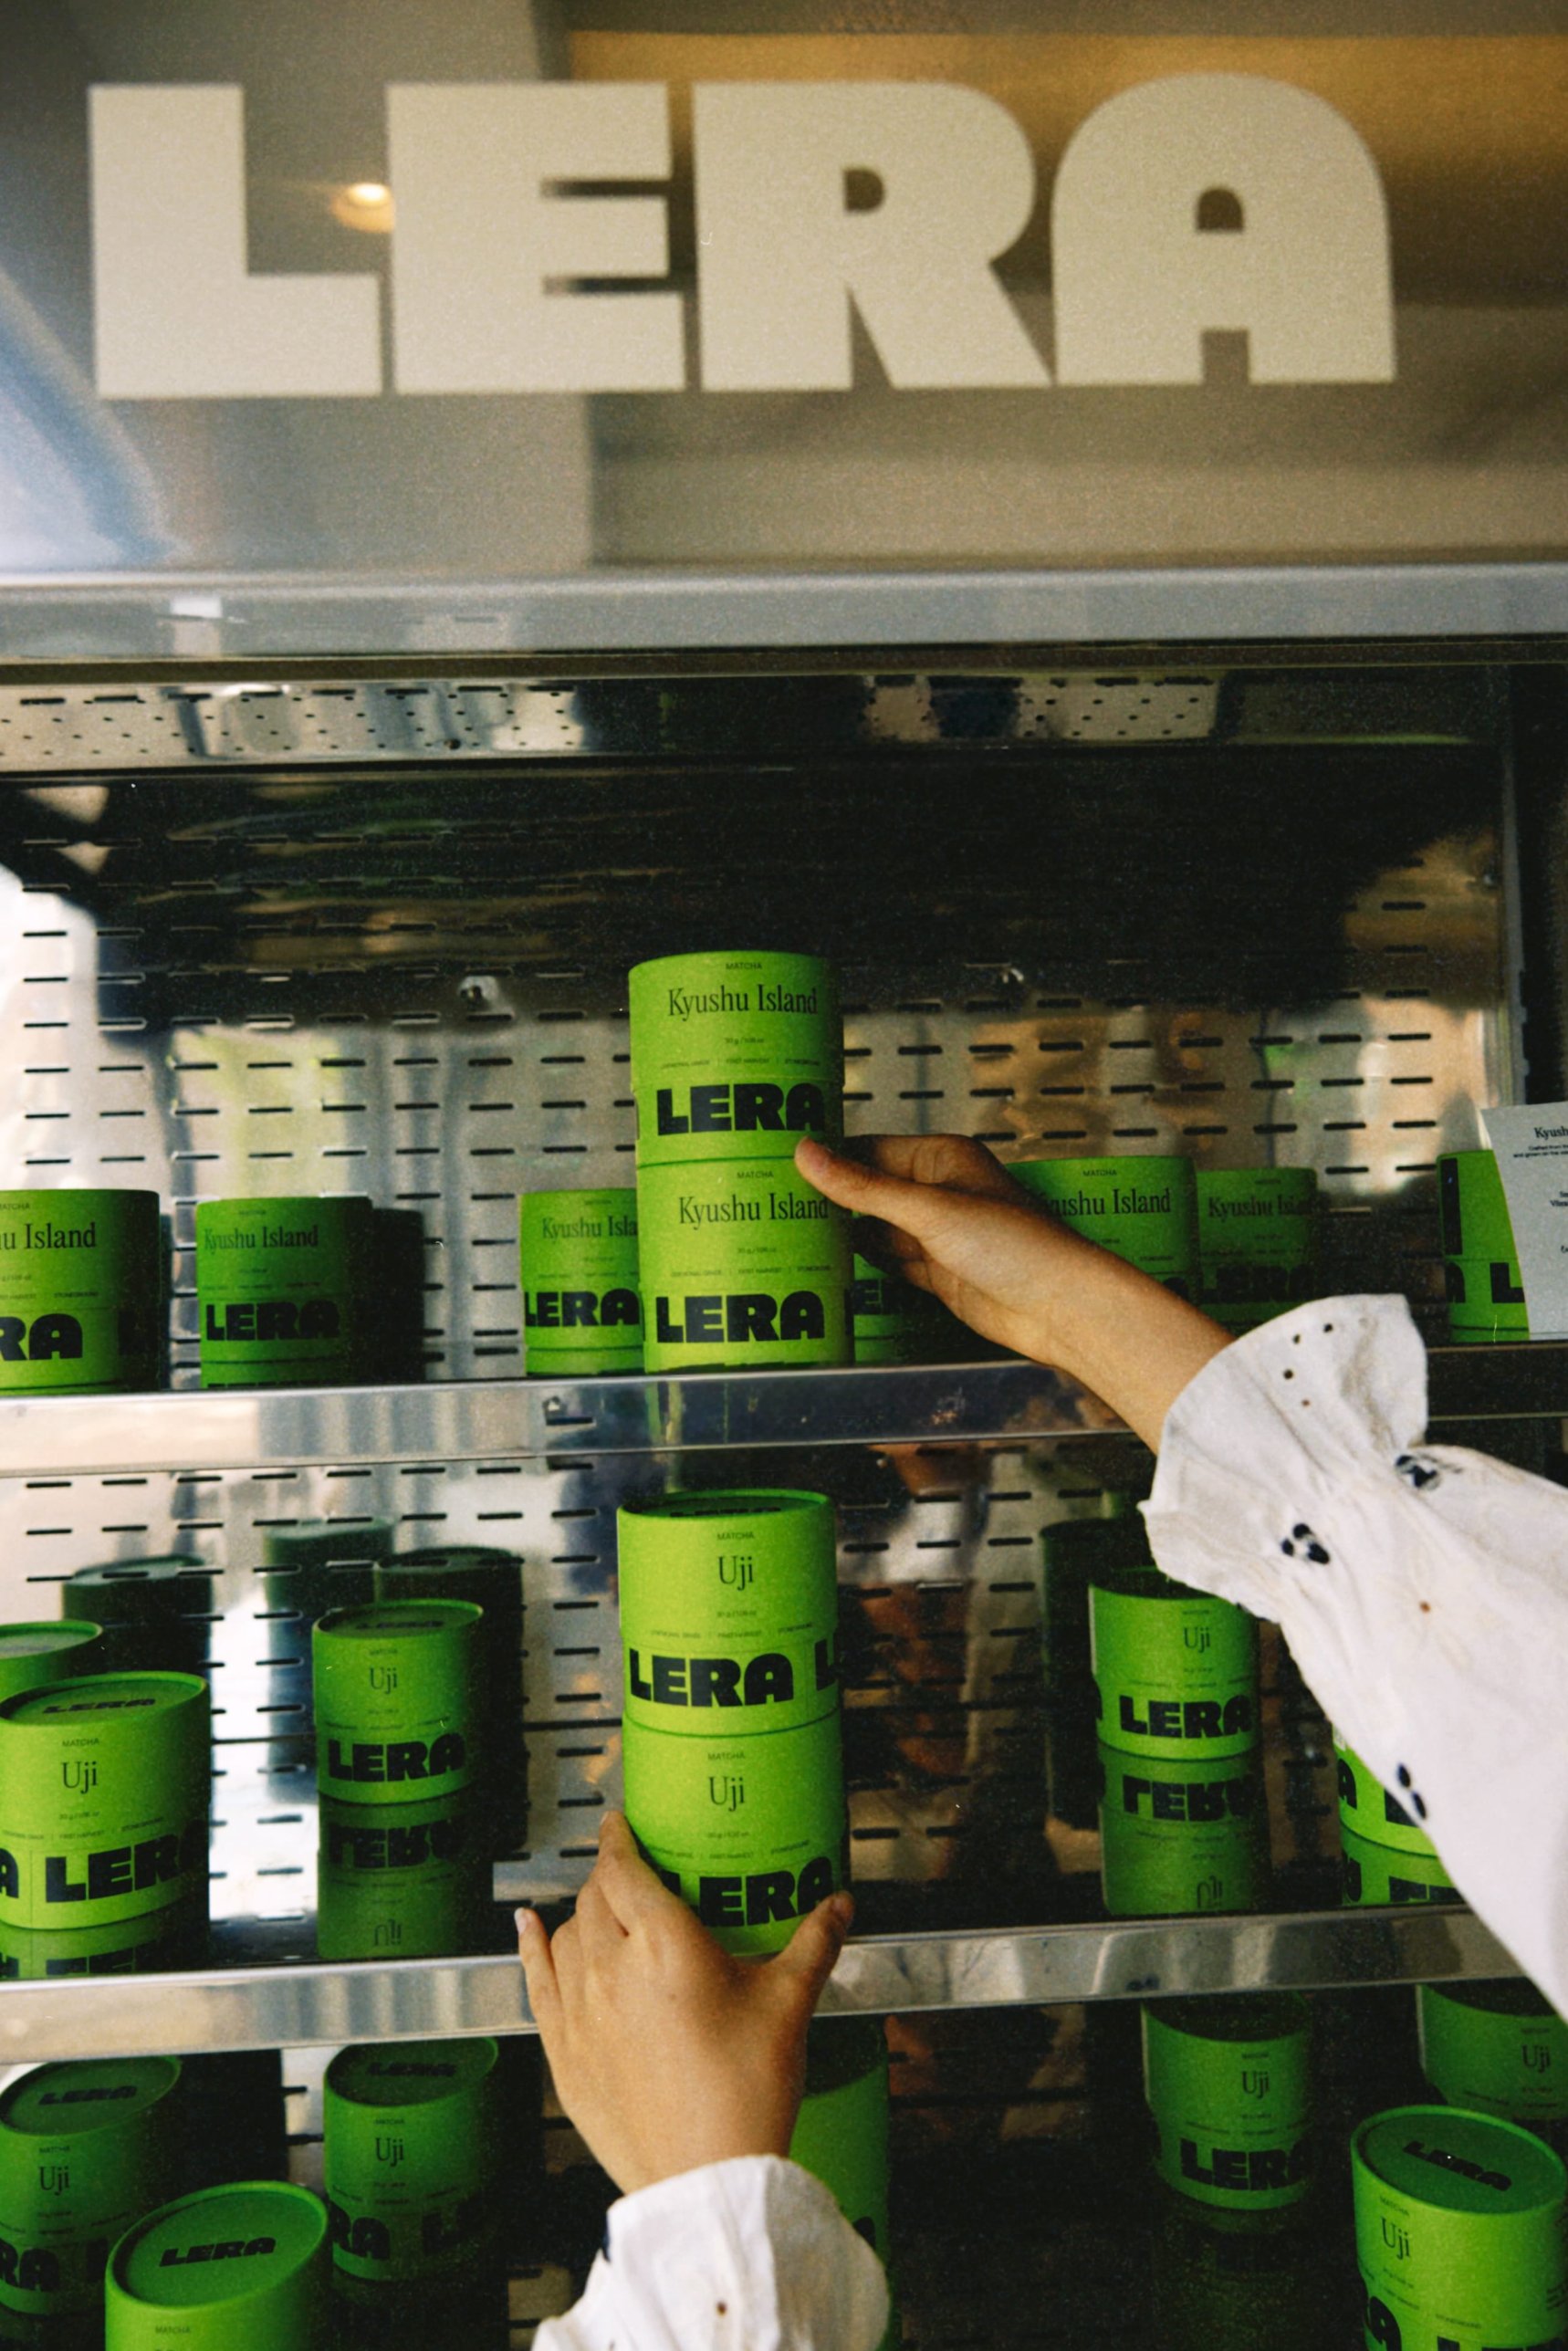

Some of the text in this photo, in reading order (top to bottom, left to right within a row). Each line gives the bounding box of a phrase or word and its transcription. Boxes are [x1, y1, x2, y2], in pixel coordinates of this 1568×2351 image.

[89, 73, 1396, 399] LERA
[726, 962, 763, 970] MATCHA
[667, 983, 819, 1022] Kyushu Island
[656, 1082, 825, 1136] LERA
[1533, 1125, 1568, 1141] Kyush
[737, 1171, 774, 1179] MATCHA
[1082, 1169, 1118, 1177] MATCHA
[679, 1192, 829, 1230] Kyushu Island
[1113, 1188, 1171, 1214] Island
[1207, 1196, 1274, 1223] Kyushu
[25, 1221, 96, 1249] Island
[204, 1225, 319, 1254] Kyushu Island
[542, 1216, 638, 1244] Kyushu Isla
[206, 1299, 341, 1341] LERA
[525, 1288, 640, 1327] LERA
[655, 1290, 825, 1343] LERA
[0, 1313, 83, 1361] RA
[716, 1531, 755, 1540] MATCHA
[718, 1555, 755, 1591] Uji
[1184, 1626, 1211, 1653] Uji
[370, 1667, 398, 1695] Uji
[629, 1647, 794, 1708] LERA
[42, 1698, 156, 1714] LERA
[1119, 1695, 1254, 1739] LERA
[62, 1738, 99, 1747] MATCHA
[329, 1733, 466, 1782] LERA
[707, 1752, 745, 1761] MATCHA
[61, 1761, 98, 1794] Uji
[708, 1776, 745, 1812] Uji
[1522, 2043, 1551, 2074] Uji
[39, 2085, 137, 2105] LERA
[1242, 2071, 1270, 2099] Uji
[375, 2137, 404, 2167] Uji
[1403, 2141, 1511, 2191] LERA
[39, 2166, 70, 2196] Uji
[159, 2237, 277, 2268] LERA
[1382, 2216, 1411, 2260] Uji
